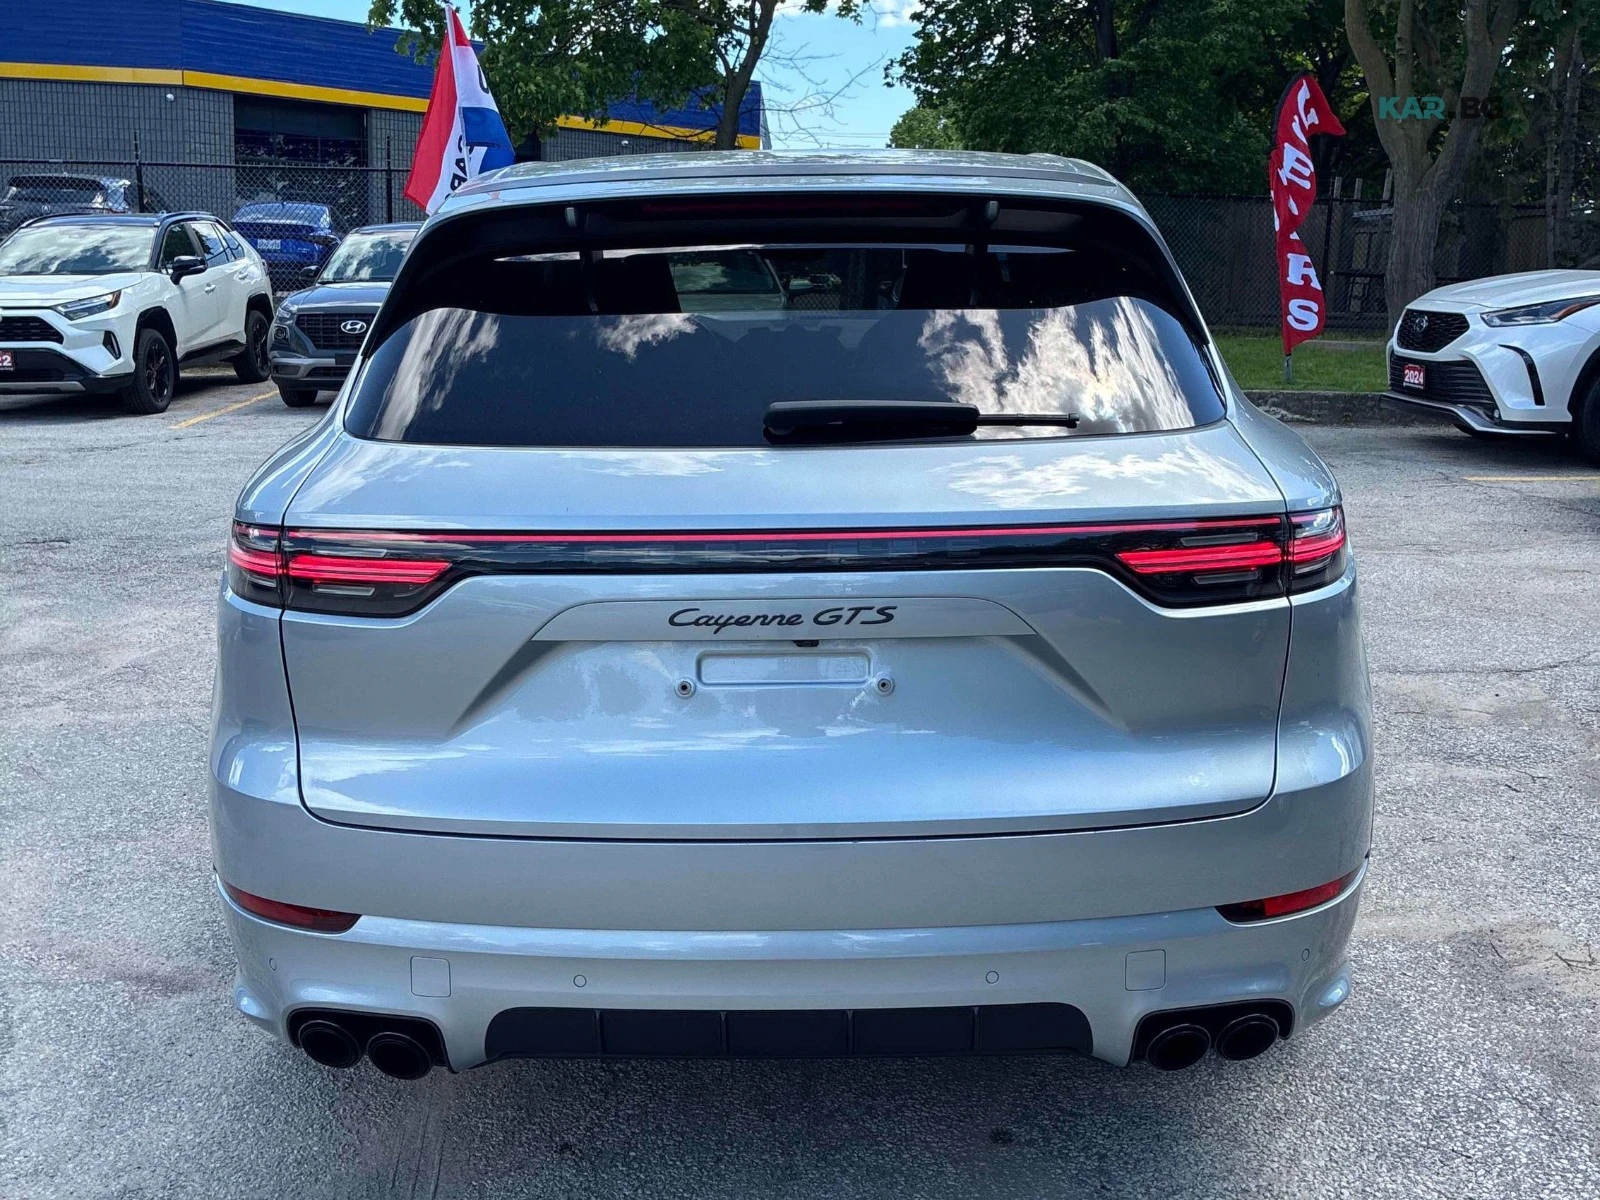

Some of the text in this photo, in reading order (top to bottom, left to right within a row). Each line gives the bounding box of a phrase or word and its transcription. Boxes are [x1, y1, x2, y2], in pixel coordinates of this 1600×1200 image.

[1404, 369, 1424, 385] 2024
[668, 605, 898, 634] Cayenne GTS
